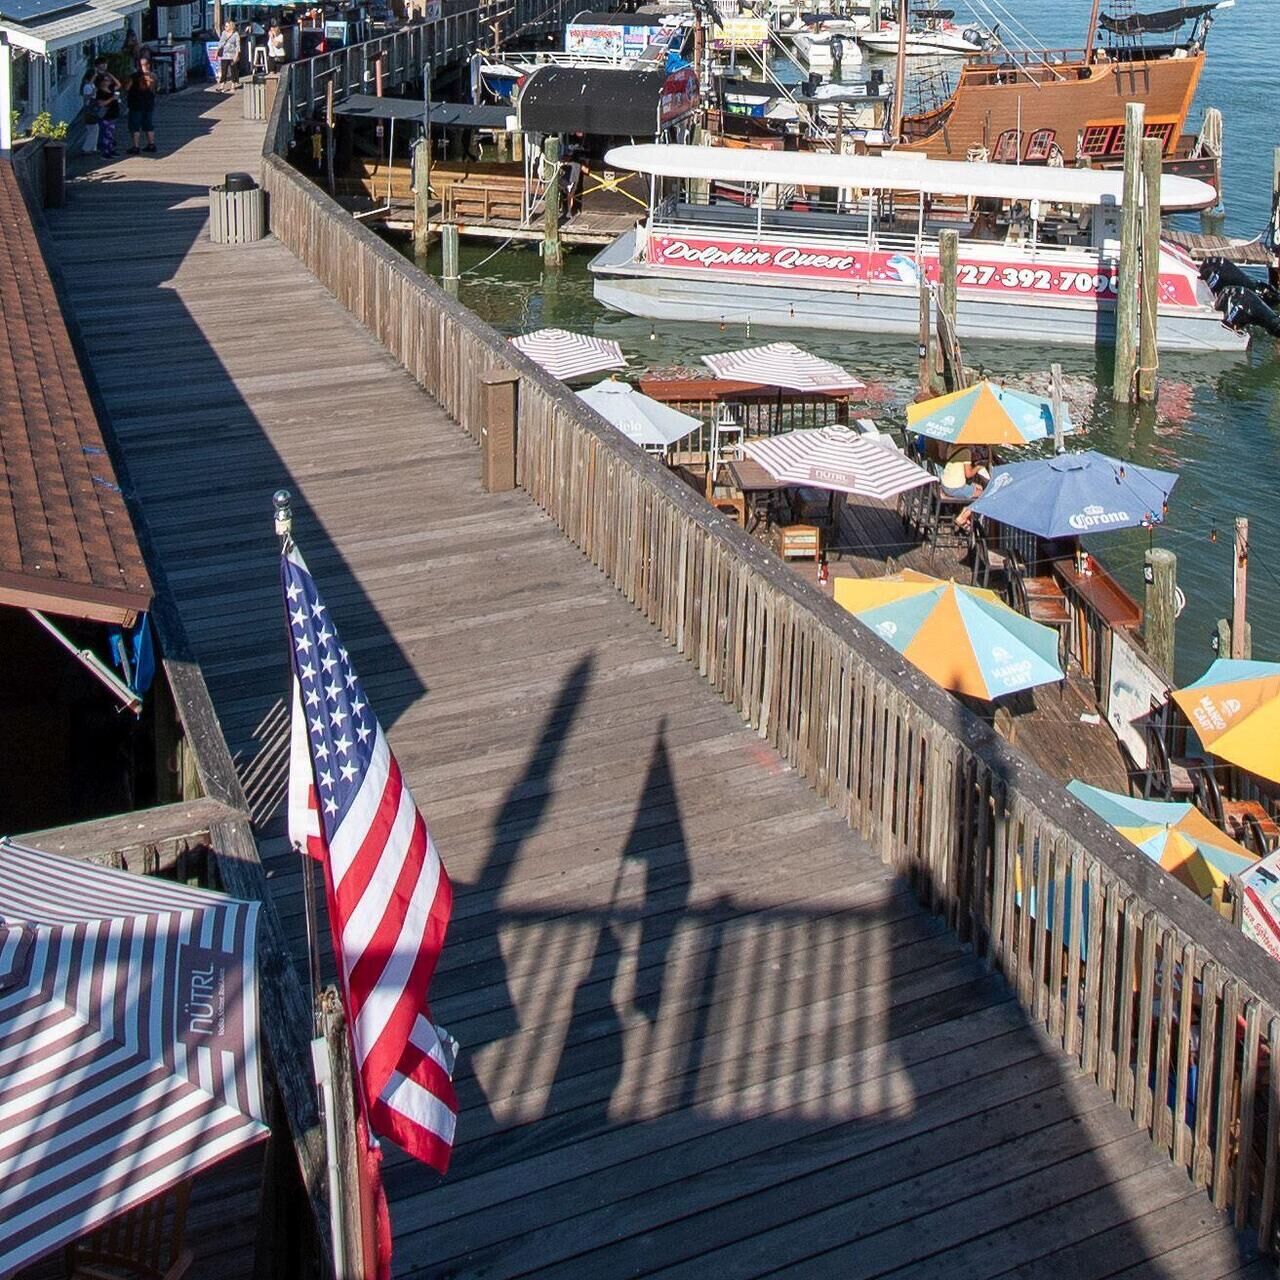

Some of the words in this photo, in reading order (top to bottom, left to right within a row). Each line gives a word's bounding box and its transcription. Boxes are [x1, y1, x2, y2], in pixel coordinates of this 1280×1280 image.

[662, 241, 771, 267] Dolphin
[772, 247, 856, 271] Quest
[1069, 511, 1130, 530] Corona
[991, 660, 1032, 679] MANGO
[1200, 695, 1227, 730] MANGO
[184, 962, 214, 1035] NÜTRL
